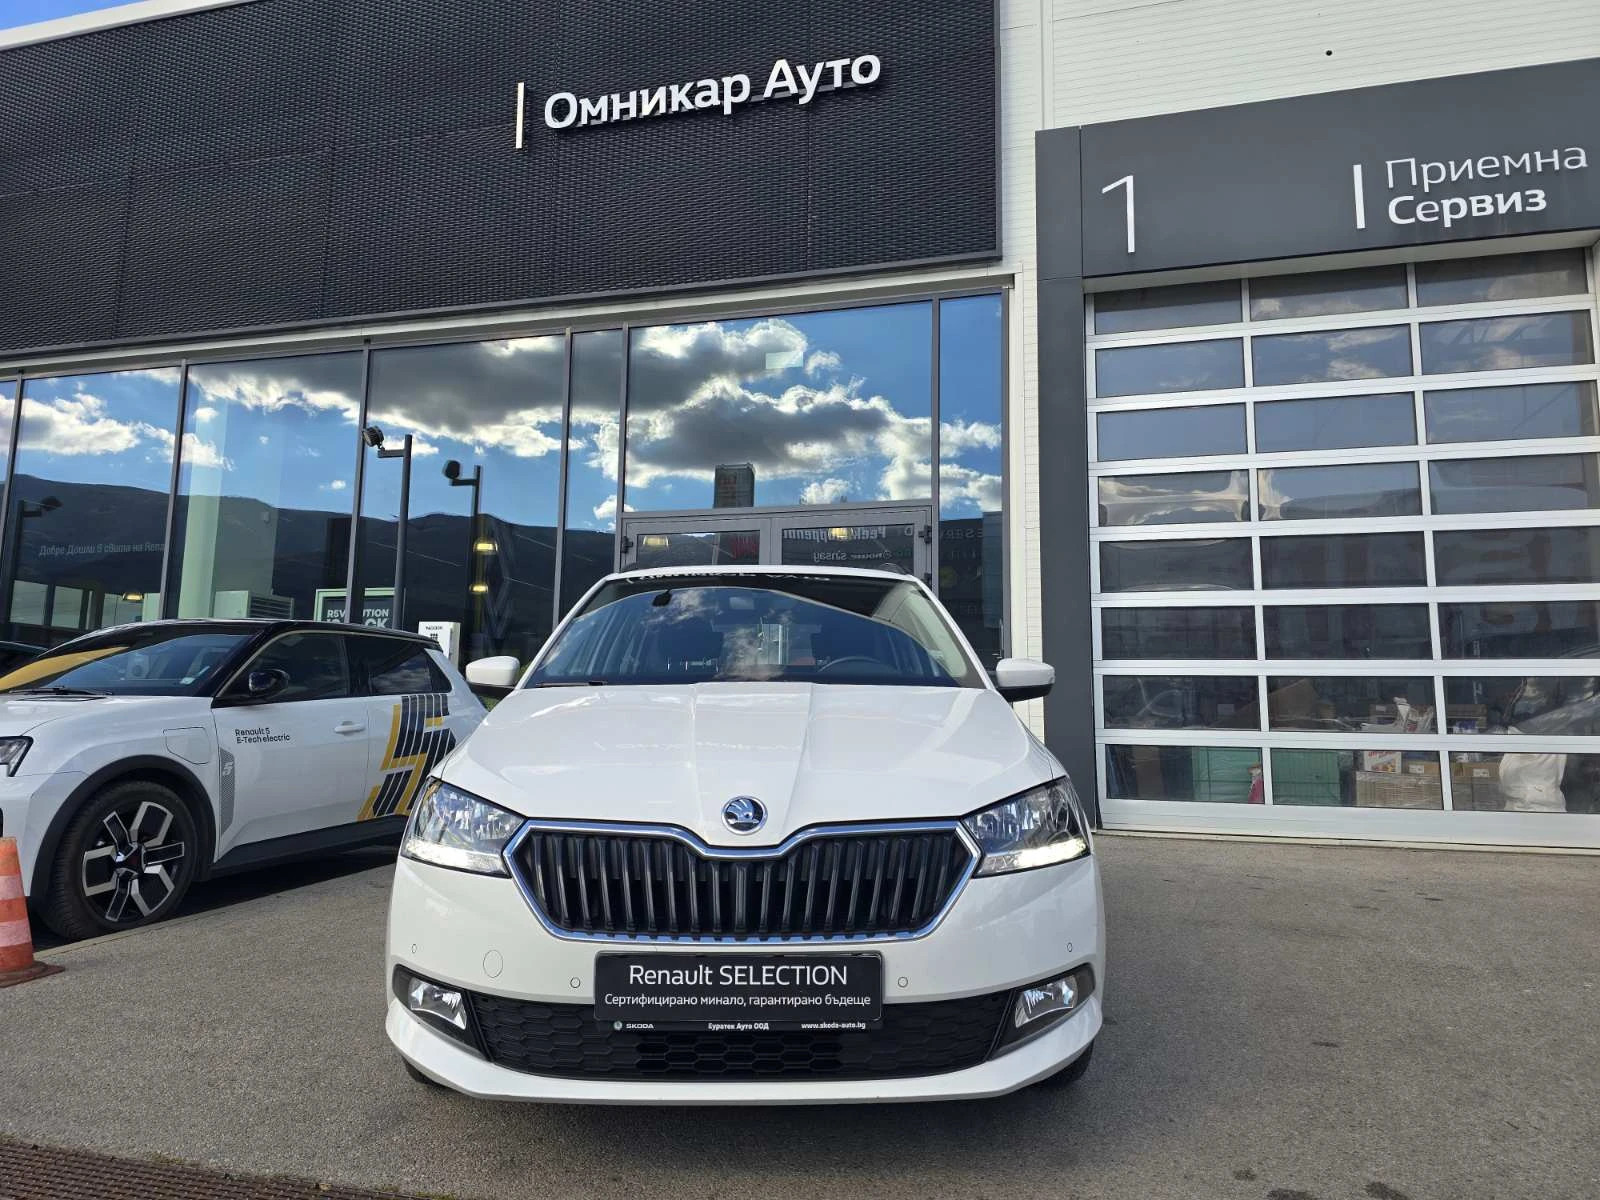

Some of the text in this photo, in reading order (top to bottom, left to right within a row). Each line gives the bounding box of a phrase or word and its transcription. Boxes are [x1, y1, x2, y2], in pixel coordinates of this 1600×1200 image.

[543, 54, 882, 129] Омникар Ауто
[1384, 146, 1589, 192] Приемна
[1101, 174, 1137, 254] 1
[1386, 188, 1548, 228] Сервиз
[235, 727, 271, 737] Renault 5
[236, 733, 290, 744] E-Tech electric
[629, 965, 848, 986] Renault SELECTION
[604, 993, 871, 1008] Сертифицирано минало, гарантирано бъдеще
[736, 1022, 753, 1031] Ауто
[753, 1022, 770, 1031] ООД
[800, 1021, 866, 1030] www.skoda-auto.bg
